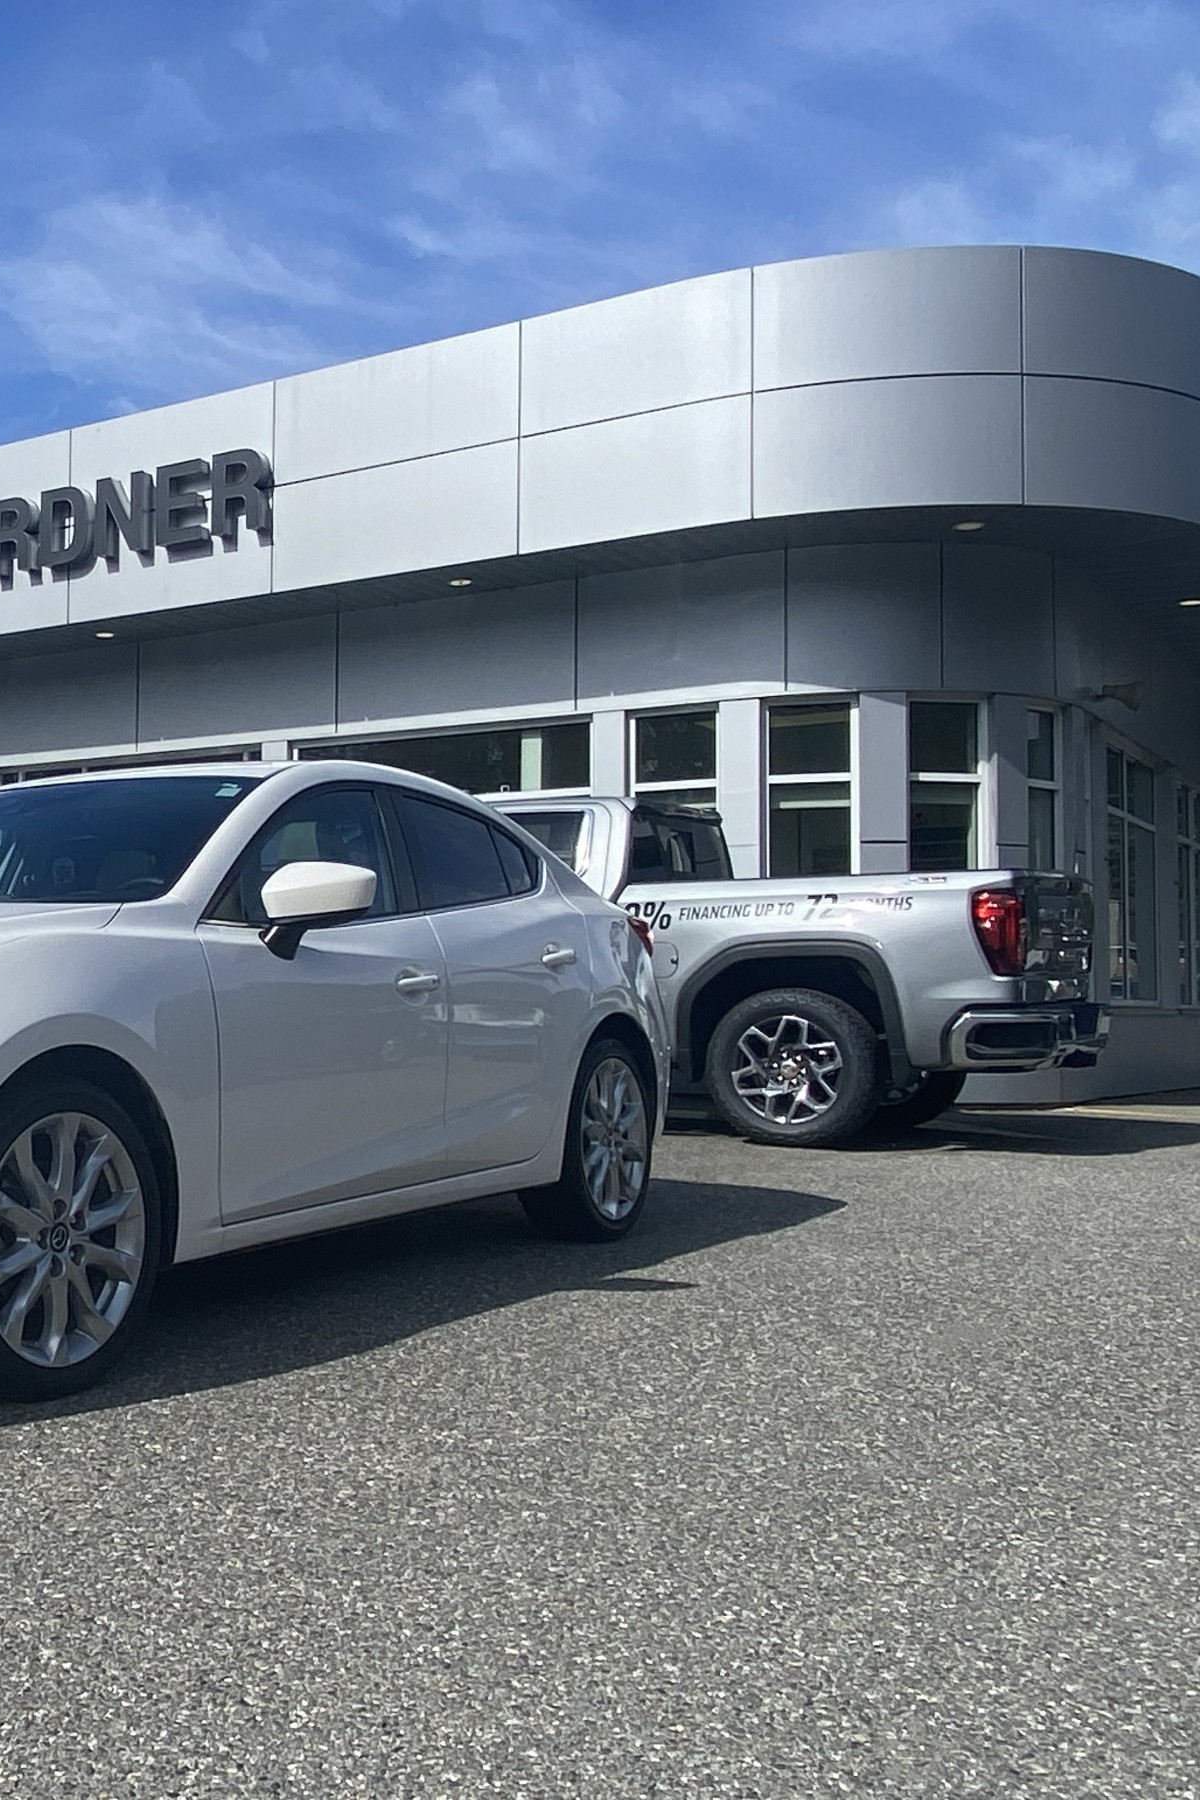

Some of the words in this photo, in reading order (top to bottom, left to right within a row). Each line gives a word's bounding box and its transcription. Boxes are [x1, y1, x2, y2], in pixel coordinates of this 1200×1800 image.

[678, 904, 751, 921] FINANCING
[754, 903, 775, 917] UP
[777, 902, 795, 916] TO
[803, 893, 839, 921] 72
